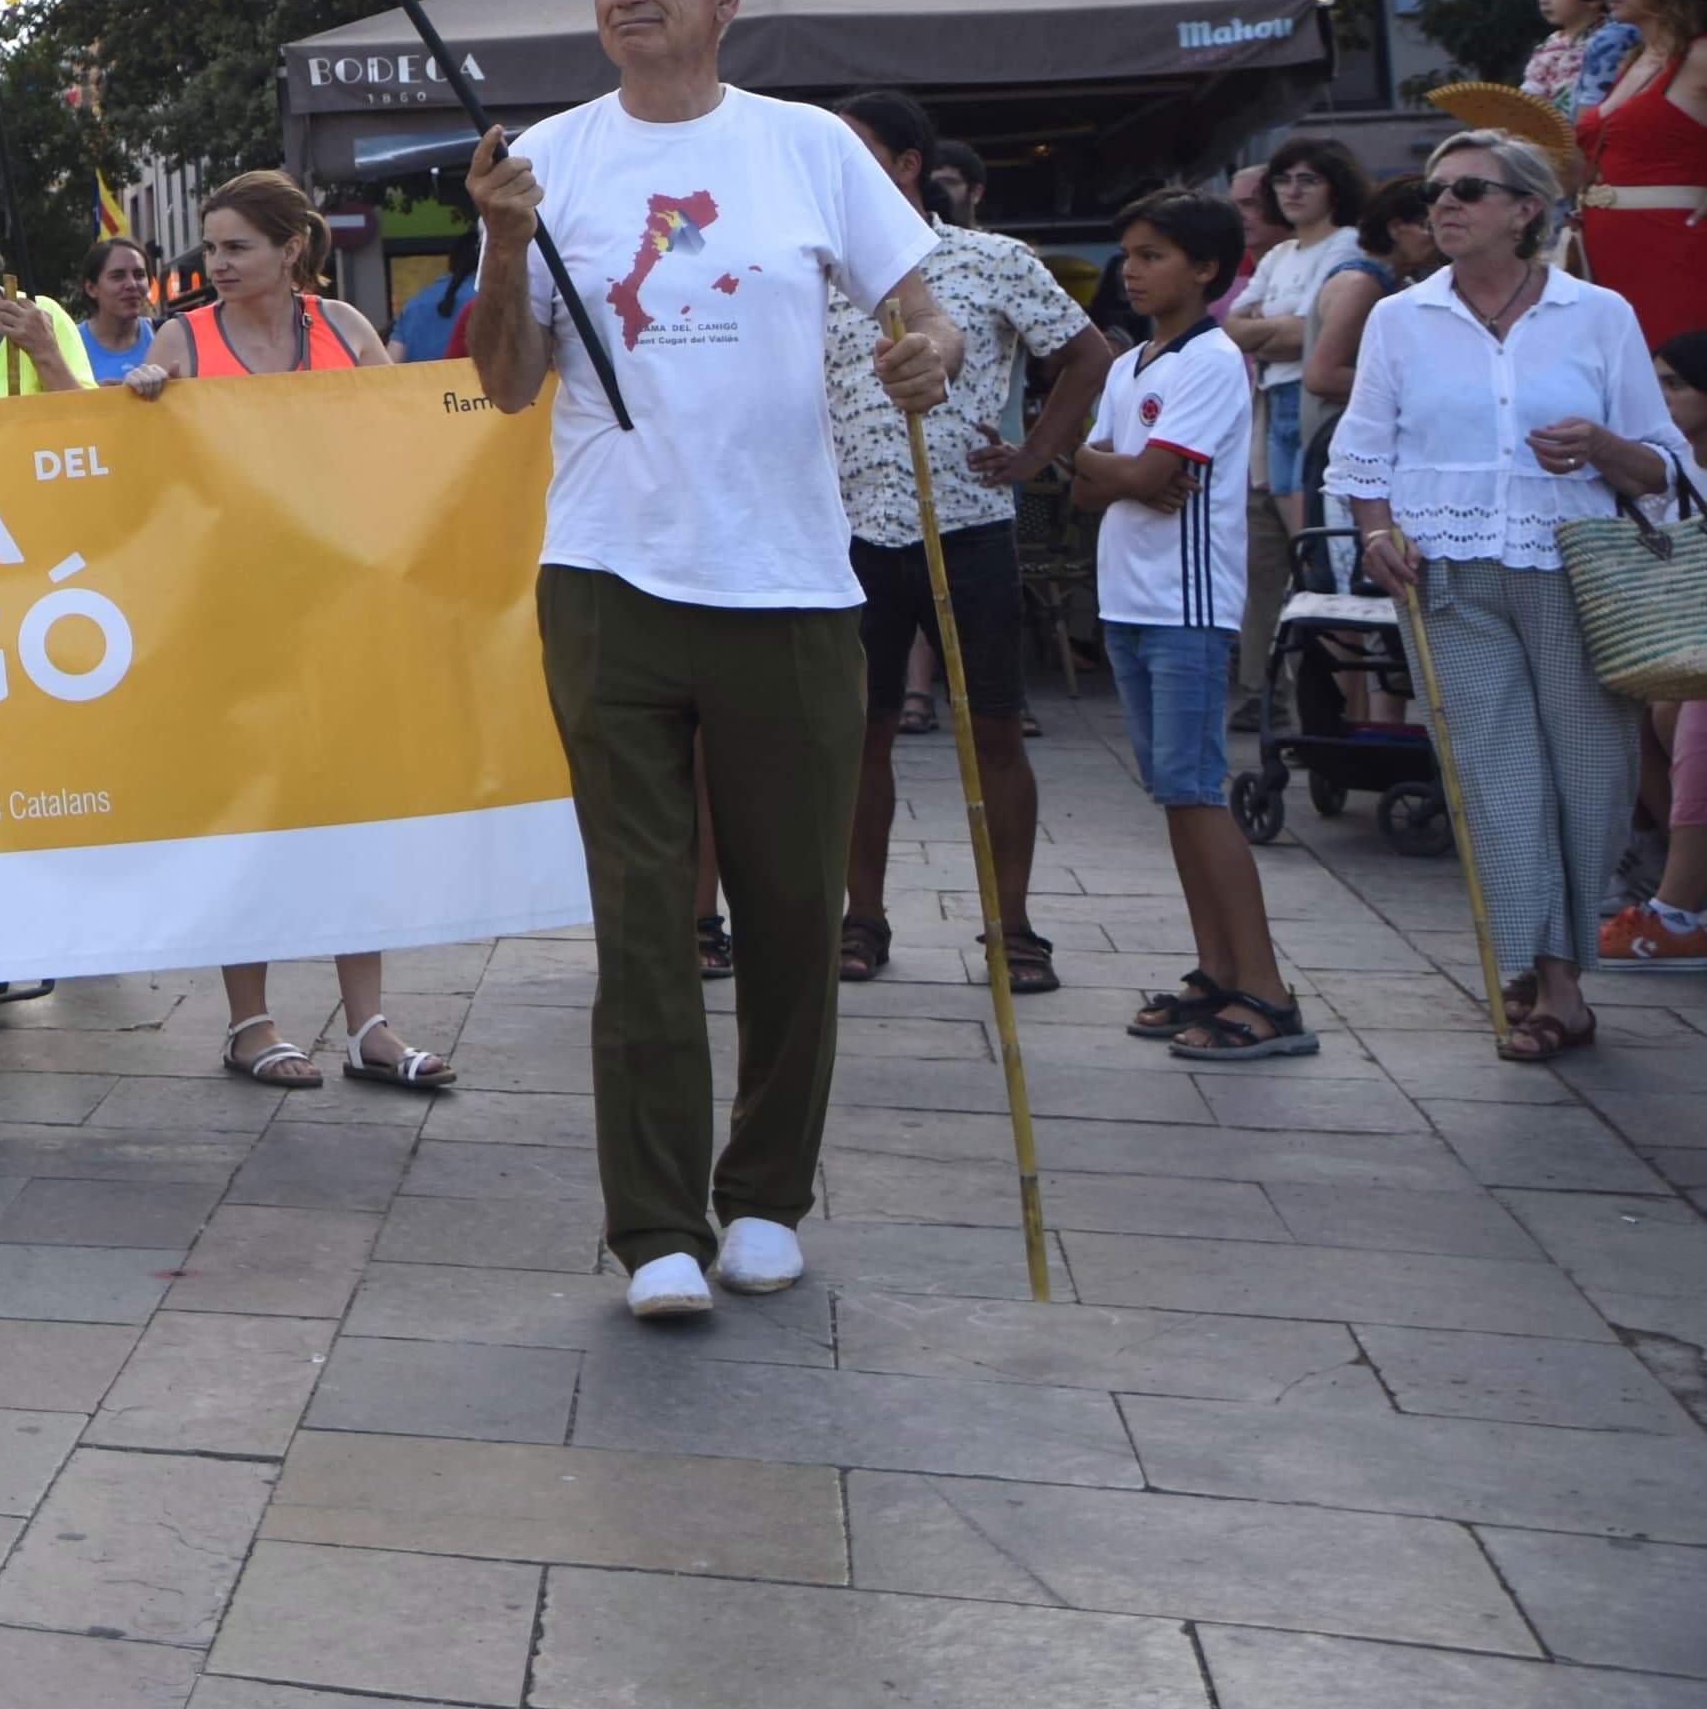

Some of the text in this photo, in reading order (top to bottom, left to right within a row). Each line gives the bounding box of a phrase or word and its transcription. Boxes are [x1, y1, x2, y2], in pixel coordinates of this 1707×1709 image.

[367, 91, 426, 104] 1860
[672, 324, 691, 332] DEL
[698, 322, 738, 330] CANIGÓ
[659, 336, 687, 345] Cugat
[34, 445, 109, 481] DEL
[9, 789, 111, 820] Catalans
